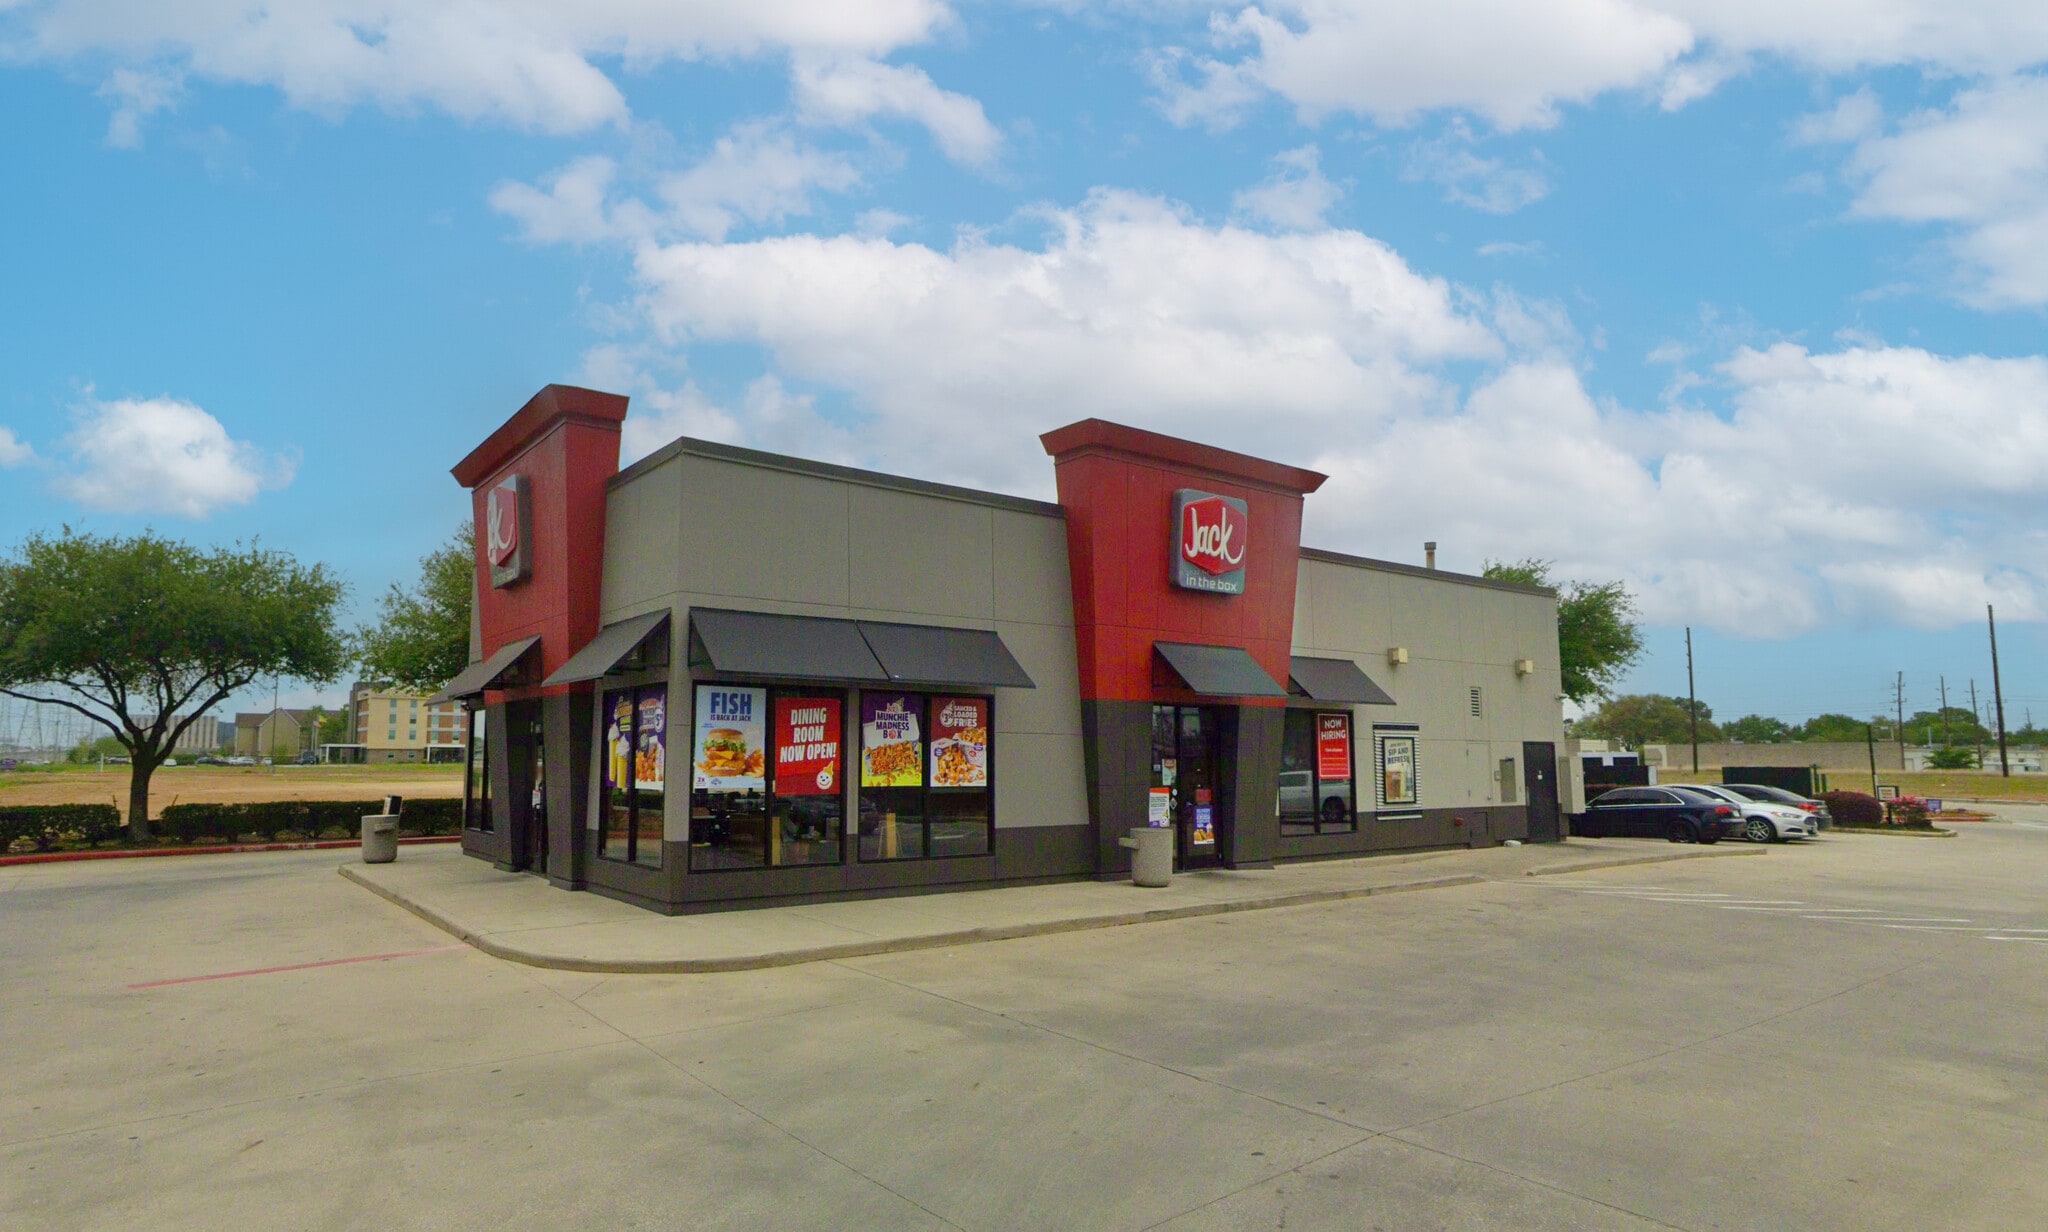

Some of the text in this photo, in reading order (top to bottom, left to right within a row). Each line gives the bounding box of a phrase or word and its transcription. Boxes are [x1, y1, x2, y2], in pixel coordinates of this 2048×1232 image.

[1185, 506, 1244, 565] Jack
[1186, 573, 1237, 592] in the box
[710, 692, 752, 714] FISH
[790, 707, 827, 726] DINING
[876, 711, 909, 721] MUNCHIE
[953, 711, 978, 719] LOADED
[953, 718, 978, 727] FRIES
[876, 721, 910, 731] MADNESS
[1324, 719, 1342, 729] NOW
[793, 725, 824, 743] ROOM
[1321, 729, 1347, 741] HIRING
[780, 742, 837, 763] NOW OPEN!
